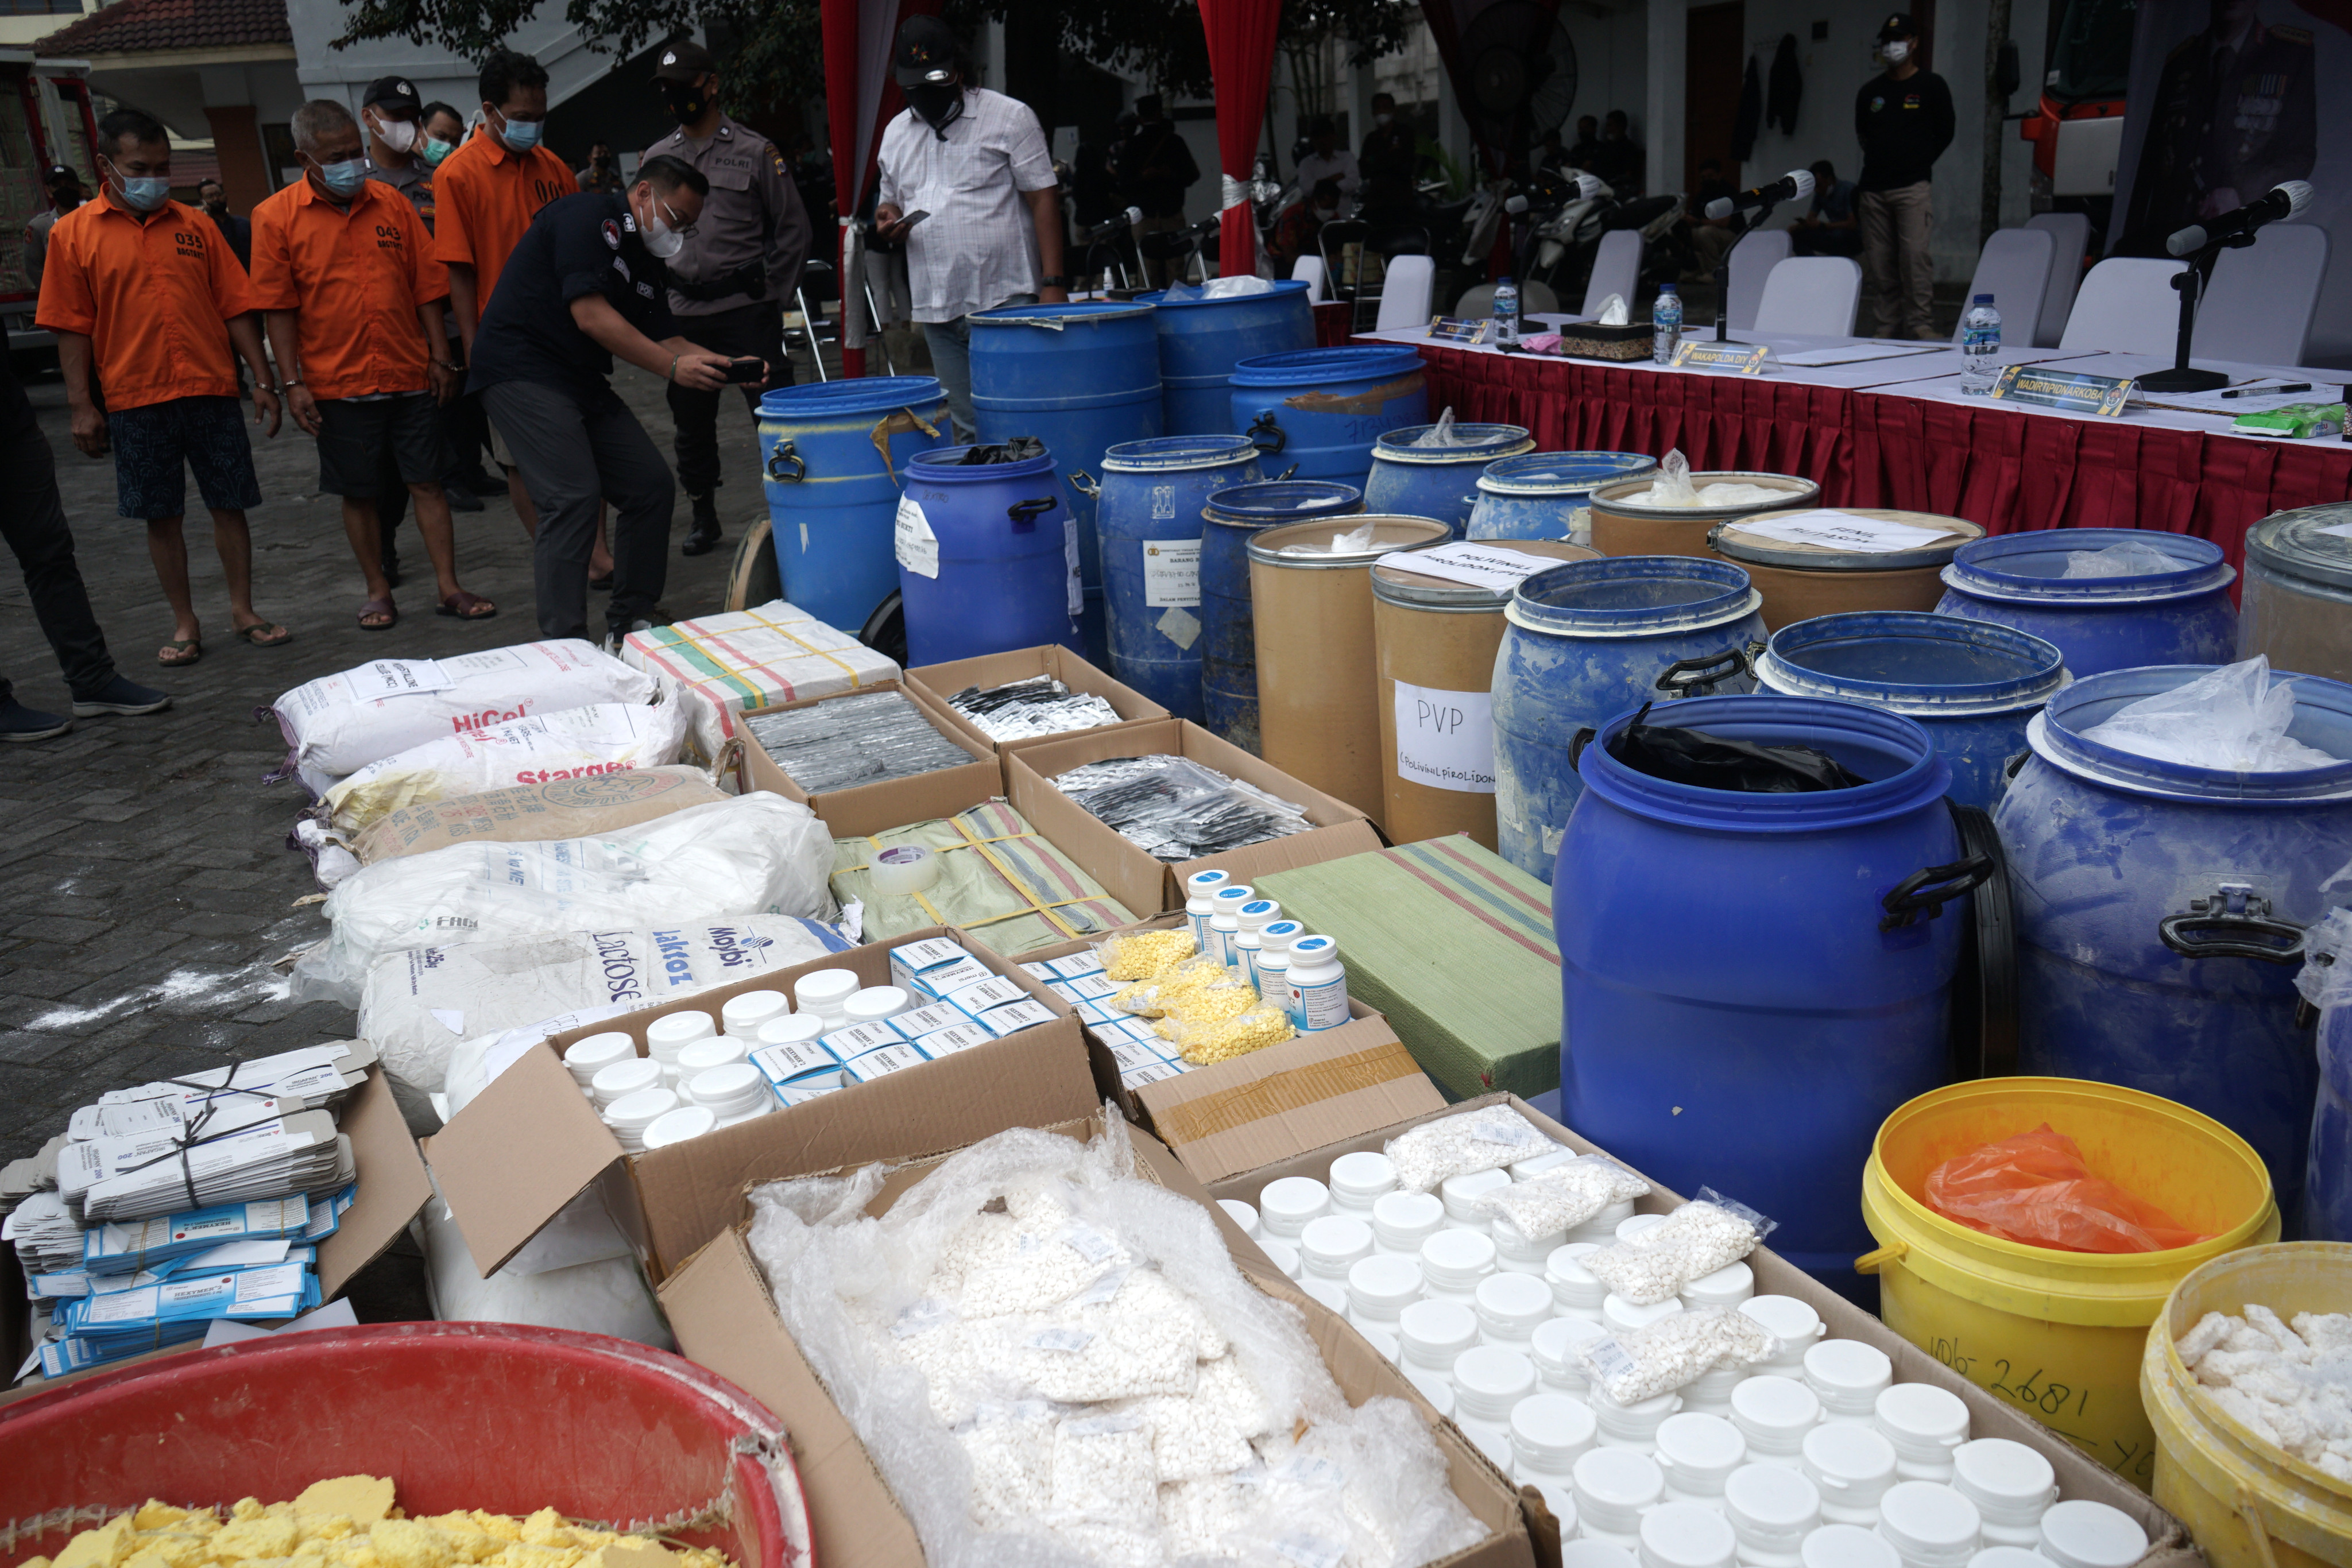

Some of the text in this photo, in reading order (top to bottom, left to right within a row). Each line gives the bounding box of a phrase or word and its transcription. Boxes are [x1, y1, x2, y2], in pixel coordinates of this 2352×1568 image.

[716, 158, 749, 169] POLRI
[413, 191, 435, 202] POL
[175, 233, 203, 249] 035
[376, 226, 401, 240] 043
[1690, 351, 1748, 364] WAKAPOLDA DIY
[2016, 378, 2103, 400] WADIRTIPIDNARKOBA
[1829, 526, 1879, 538] FENIL
[451, 704, 526, 733] HiCel
[1418, 699, 1463, 735] PVP
[516, 760, 633, 785] Starge
[652, 930, 693, 986] Laktoz
[593, 931, 642, 1003] Lactose
[92, 1148, 103, 1179] IRGAPAN 200
[117, 1152, 133, 1160] 200
[195, 1221, 231, 1230] HEXYMER
[174, 1288, 214, 1298] HEXYMER
[1990, 1358, 2088, 1415] 2681
